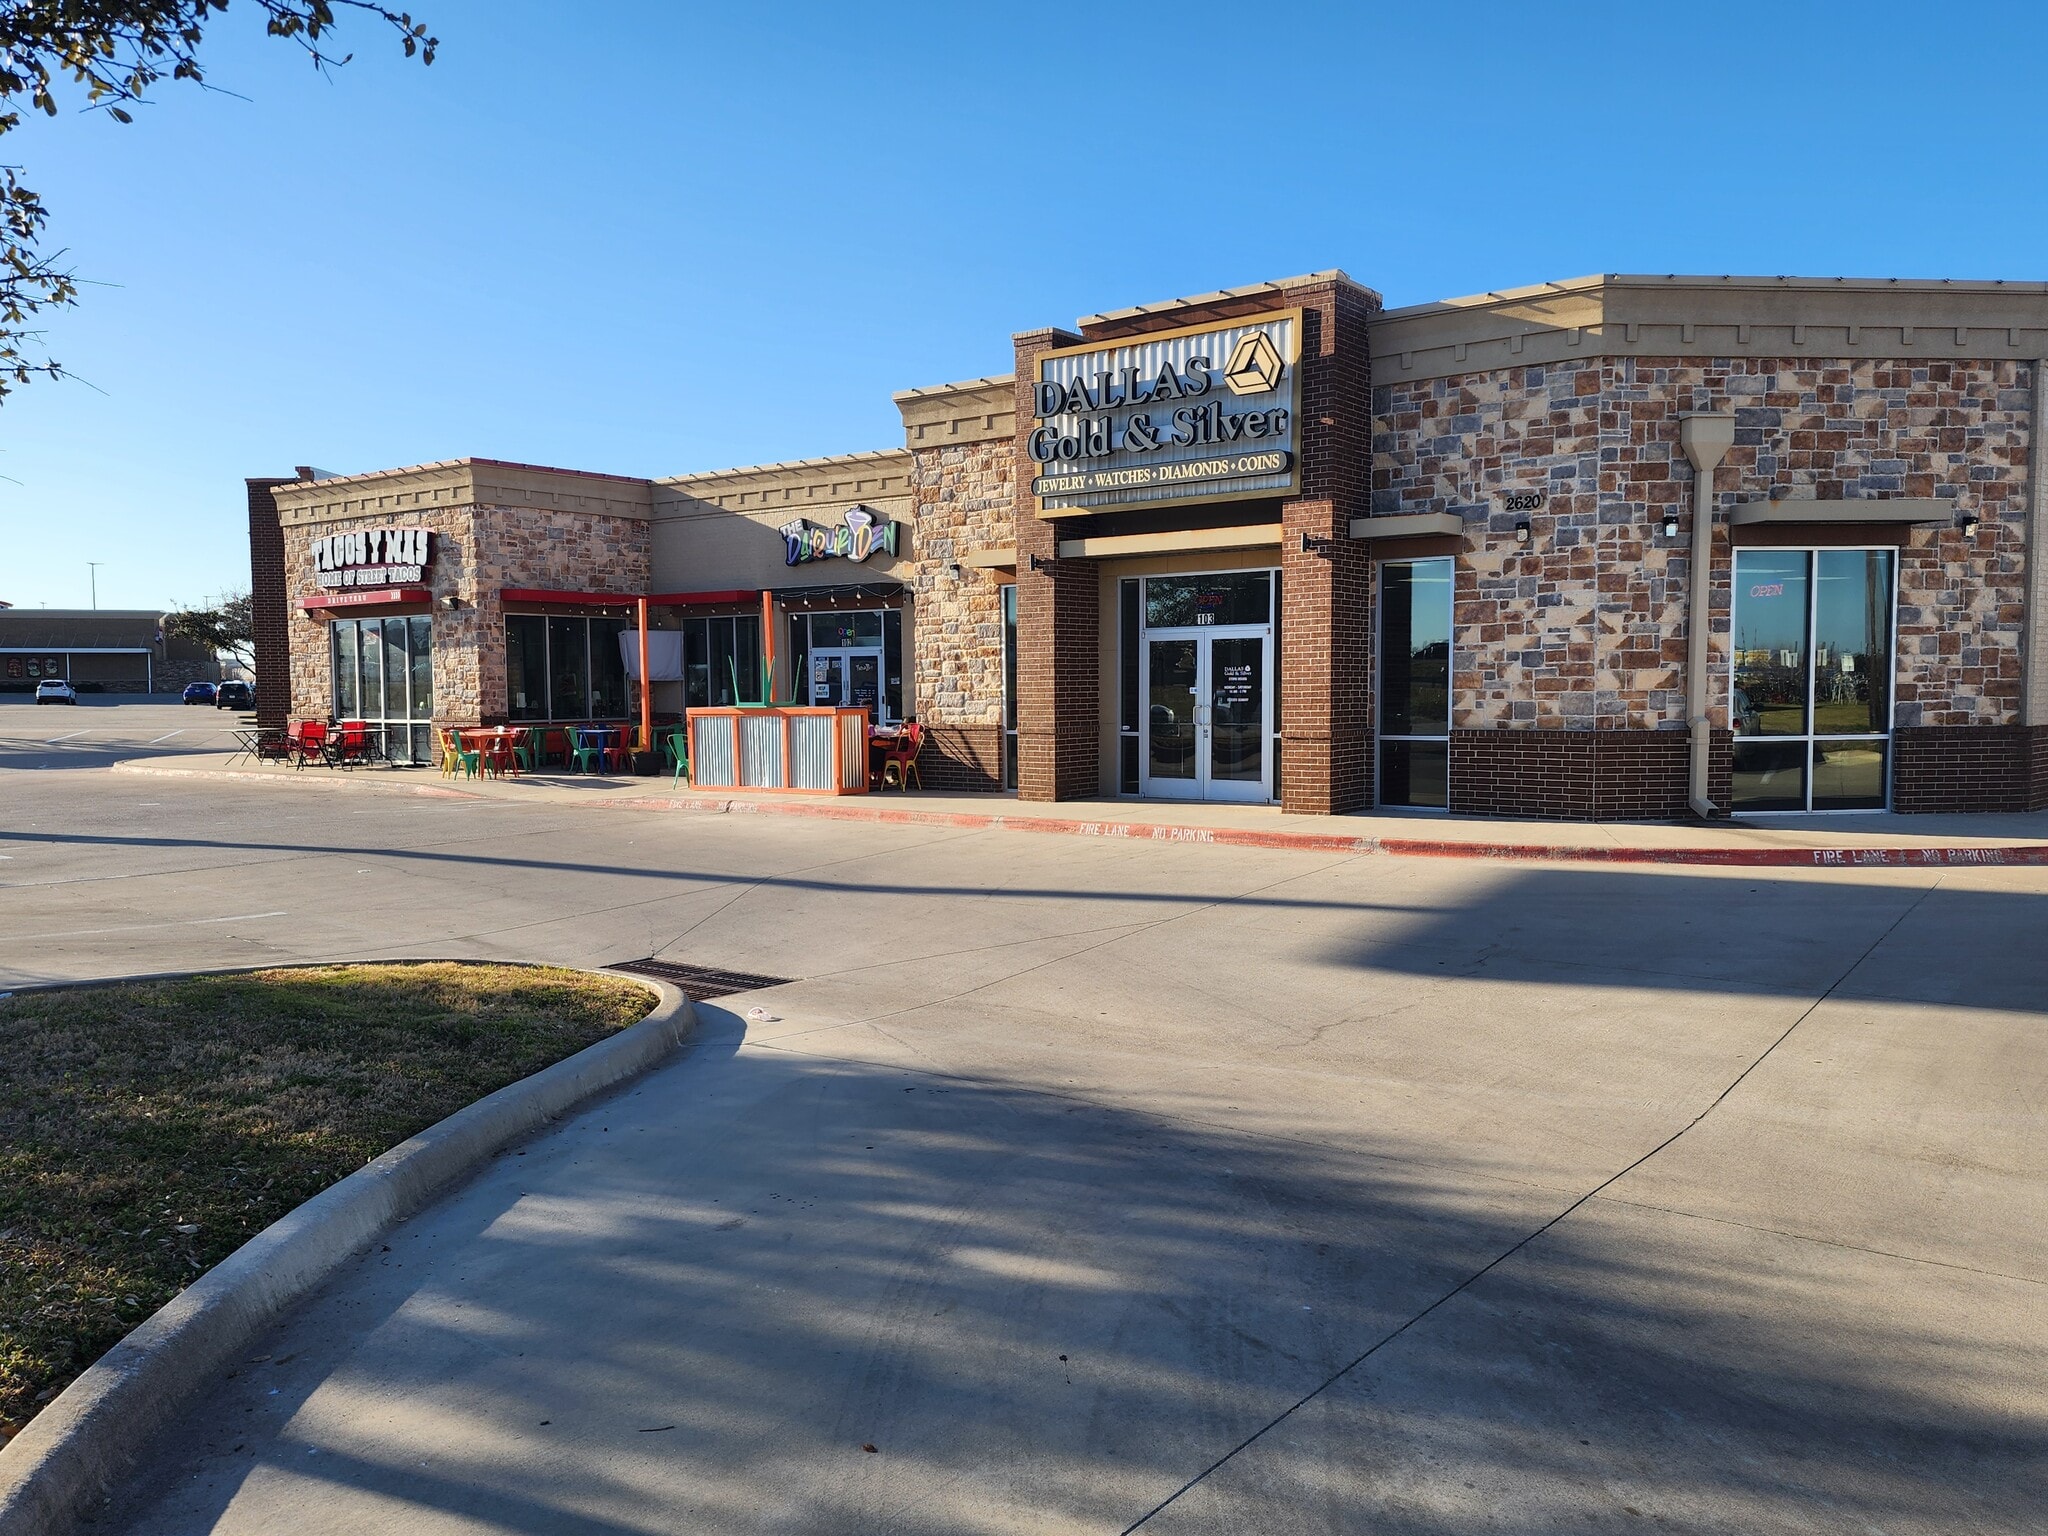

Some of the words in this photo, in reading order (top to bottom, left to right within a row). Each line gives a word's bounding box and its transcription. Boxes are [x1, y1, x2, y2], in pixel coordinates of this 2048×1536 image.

[1032, 356, 1211, 418] DALLAS
[1028, 416, 1112, 463] Gold
[1122, 413, 1163, 452] &
[1171, 400, 1288, 448] Silver
[1037, 475, 1086, 494] JEWELRY
[1095, 468, 1151, 487] WATCHES
[1159, 460, 1229, 480] DIAMONDS
[1237, 454, 1280, 472] COINS
[1505, 494, 1541, 511] 2620
[780, 519, 804, 537] THE
[311, 531, 367, 571] TACOS
[369, 530, 382, 564] Y
[385, 530, 428, 566] MAS
[858, 520, 897, 560] DEN
[317, 570, 342, 588] HOME
[342, 569, 356, 586] OF
[356, 567, 387, 585] STREET
[388, 565, 421, 583] TACOS
[1751, 584, 1783, 597] OPEN
[1198, 613, 1214, 624] 103
[1079, 822, 1101, 836] FIRE
[1103, 824, 1130, 838] LANE
[1151, 827, 1167, 840] NO
[1170, 828, 1214, 842] PARKING
[1813, 850, 1846, 864] FIRE
[1852, 849, 1891, 864] LANE
[1921, 849, 1942, 863] NO
[1948, 848, 2005, 864] PARKING
